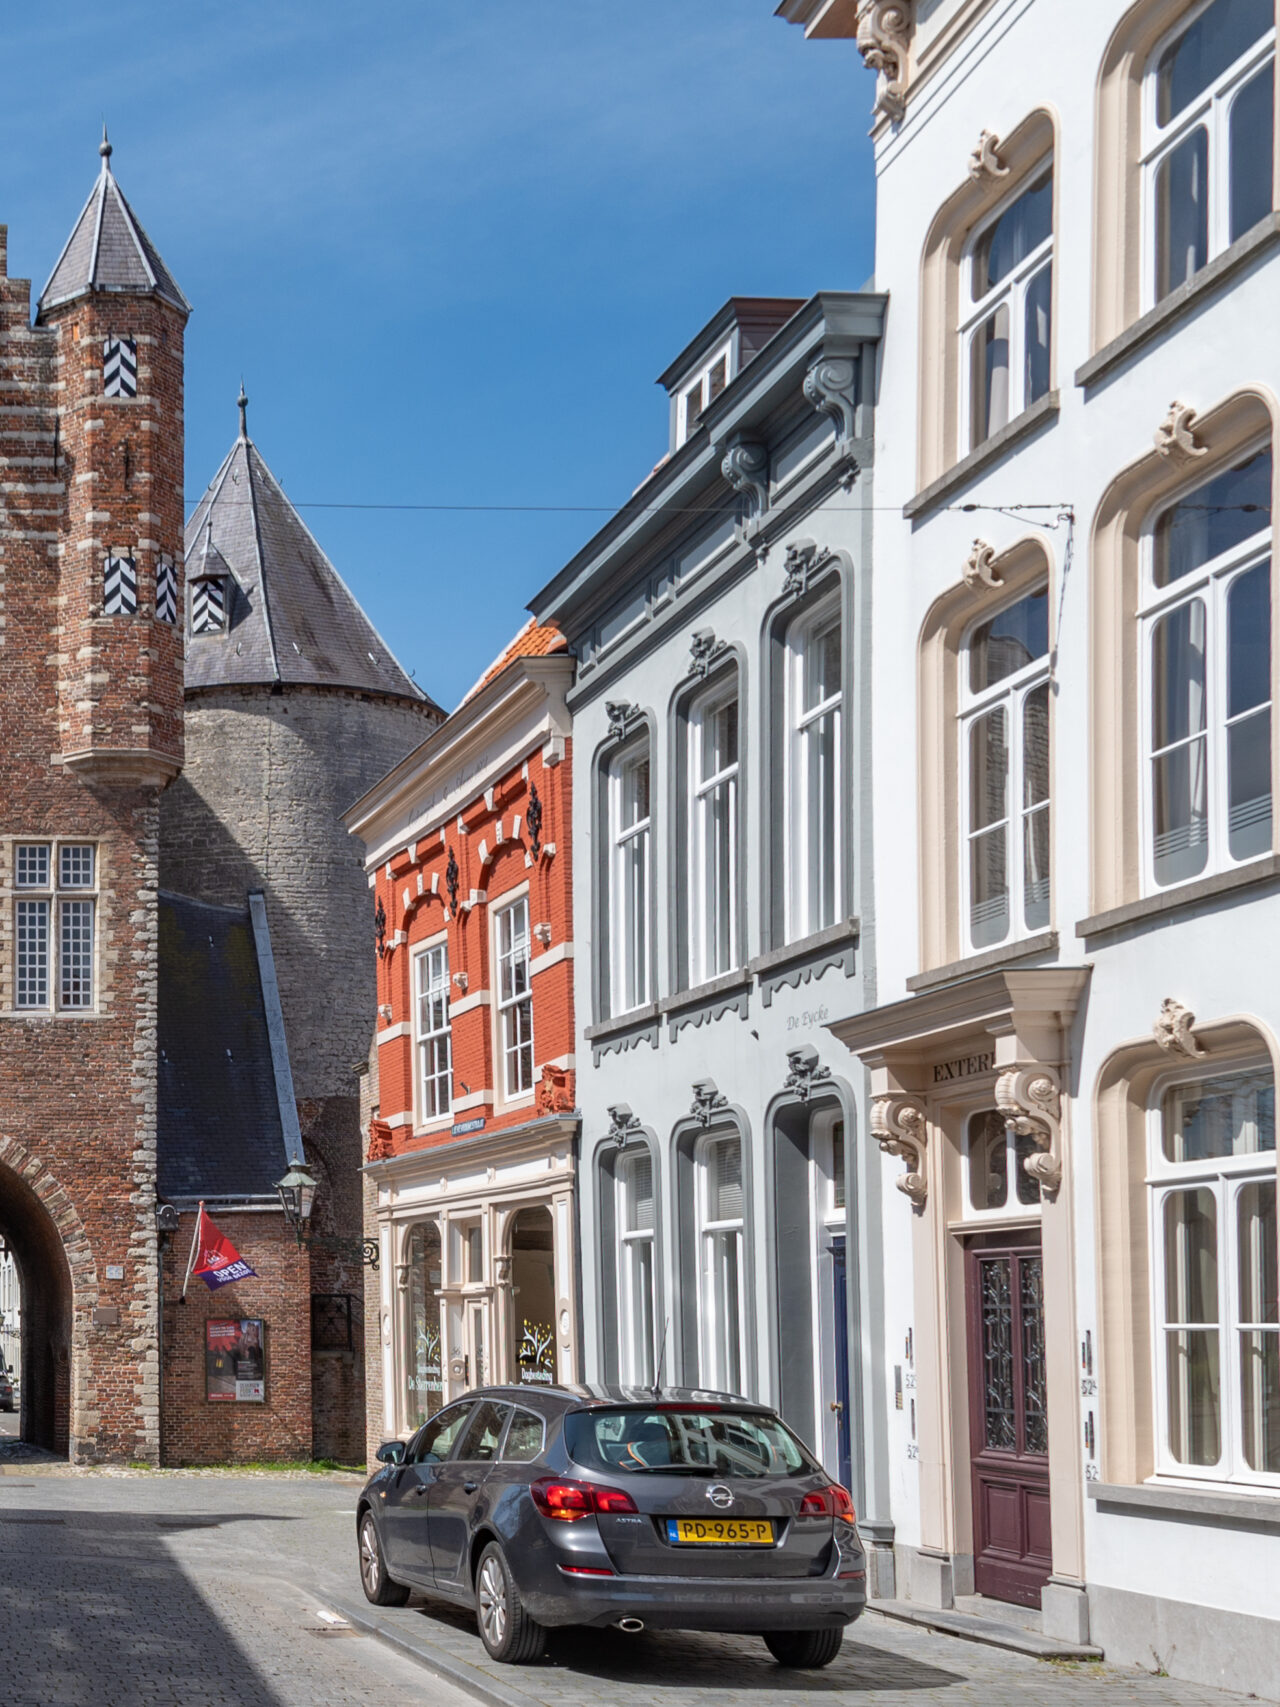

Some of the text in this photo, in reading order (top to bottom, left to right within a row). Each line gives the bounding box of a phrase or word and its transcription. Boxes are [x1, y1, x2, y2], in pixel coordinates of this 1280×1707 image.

[786, 1015, 799, 1031] De
[212, 1261, 247, 1278] OPEN
[683, 1522, 767, 1540] PD-965-P
